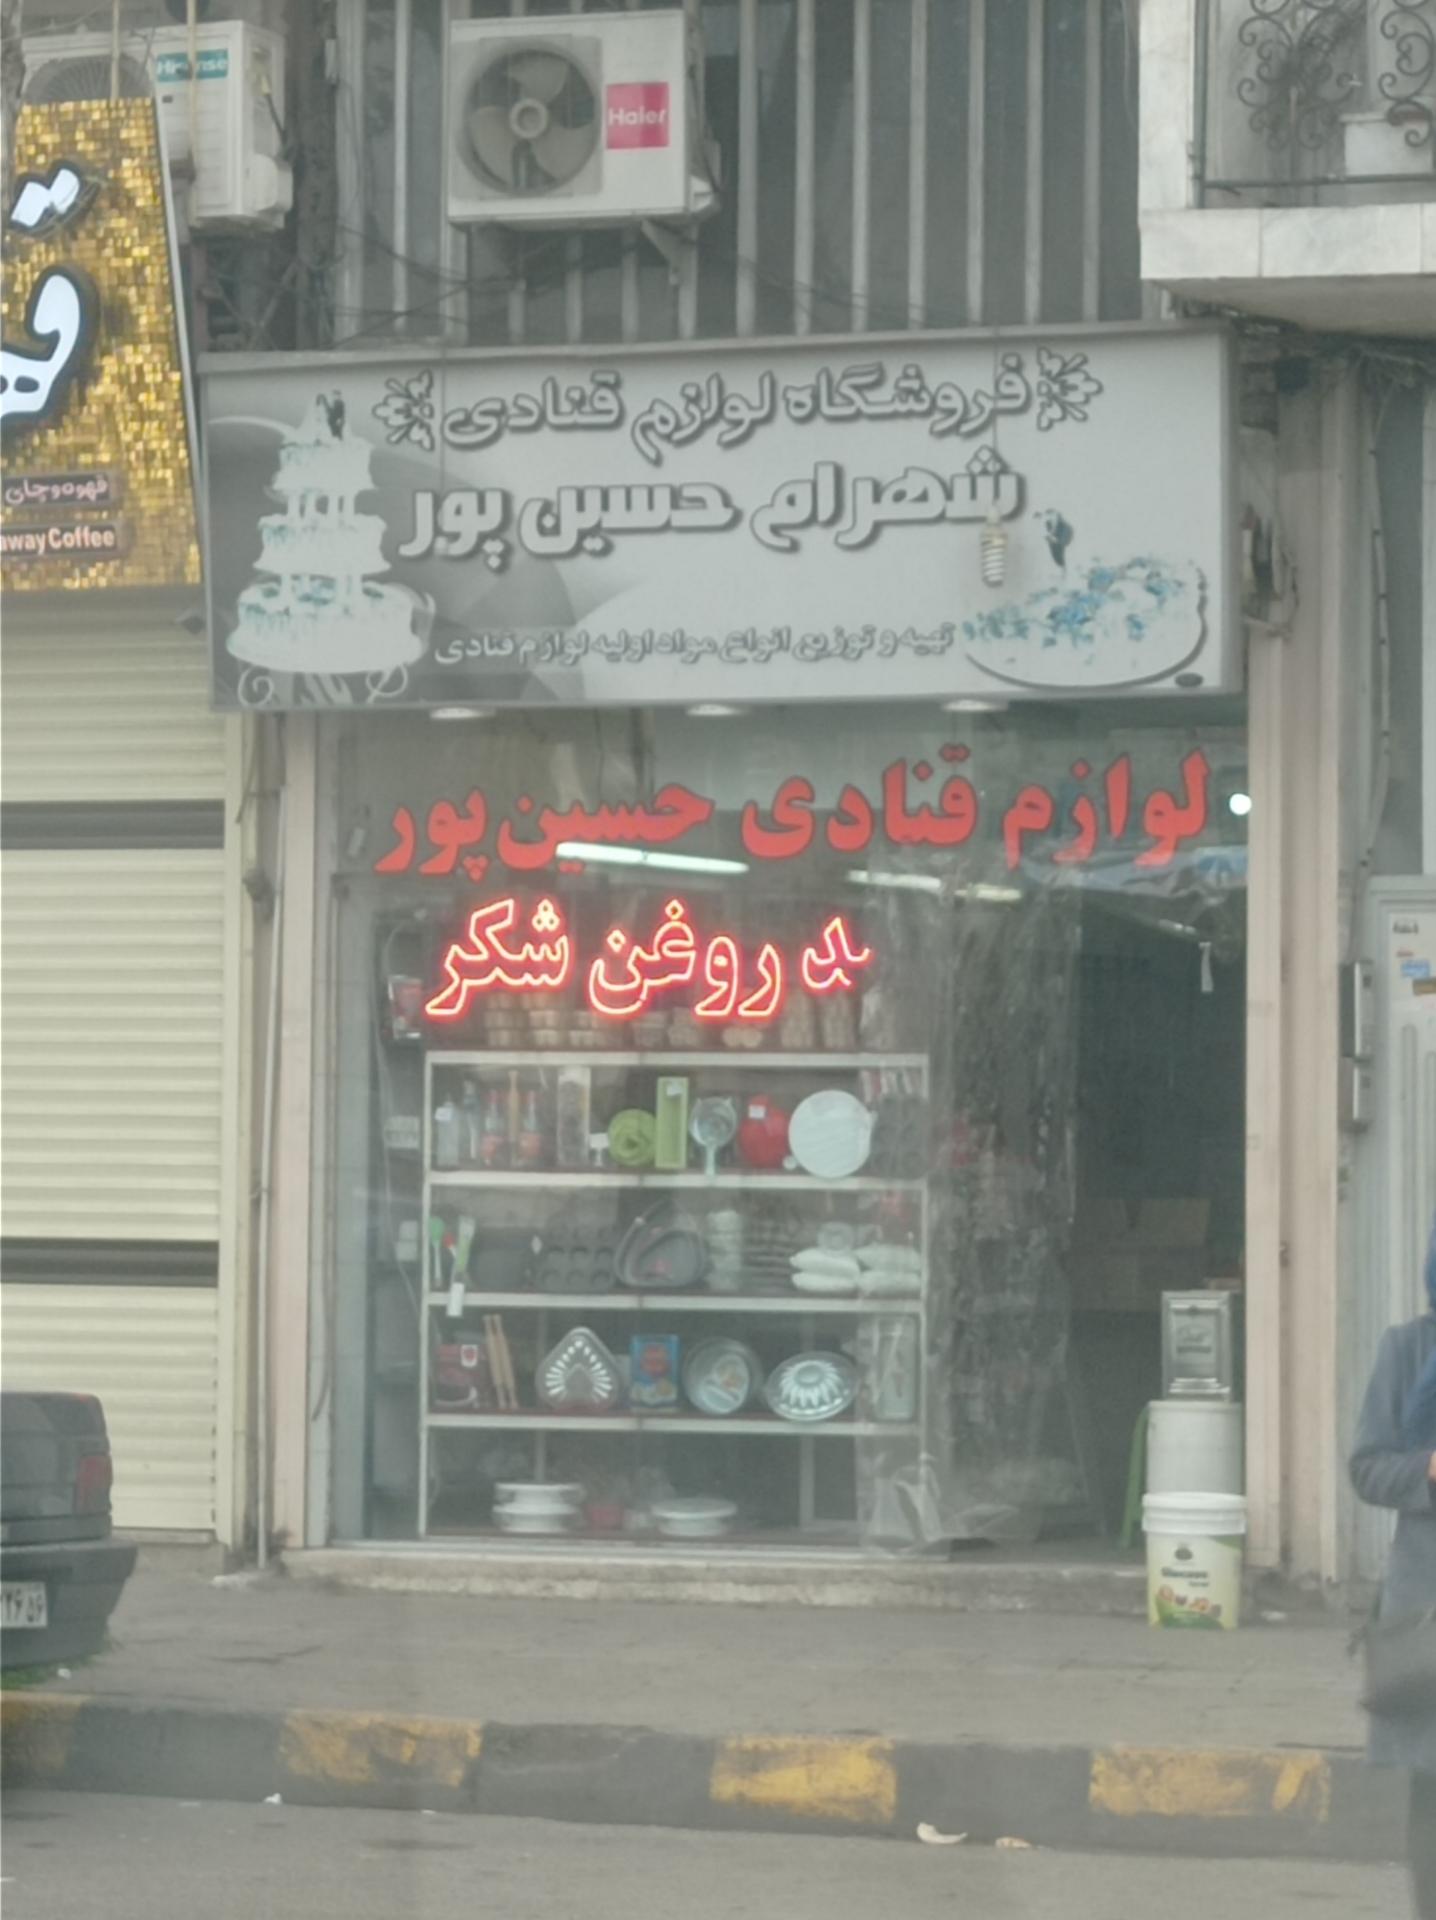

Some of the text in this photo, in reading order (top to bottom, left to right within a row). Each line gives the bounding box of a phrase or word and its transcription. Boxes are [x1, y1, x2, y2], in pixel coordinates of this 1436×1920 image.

[608, 106, 666, 126] Haier
[442, 353, 1032, 467] فروشگاه لوازم قنادی
[398, 445, 1026, 573] شهرام حسین پور
[434, 632, 515, 664] قنادی
[519, 629, 590, 666] لوازم
[592, 628, 654, 664] اولیه
[655, 628, 718, 665] مواد
[718, 624, 792, 664] انواع
[792, 623, 876, 663] توزیع
[876, 628, 899, 659] و
[374, 743, 1211, 883] لوازم قنادی حسین پور
[425, 898, 570, 1017] شکر
[588, 898, 783, 1018] روغن
